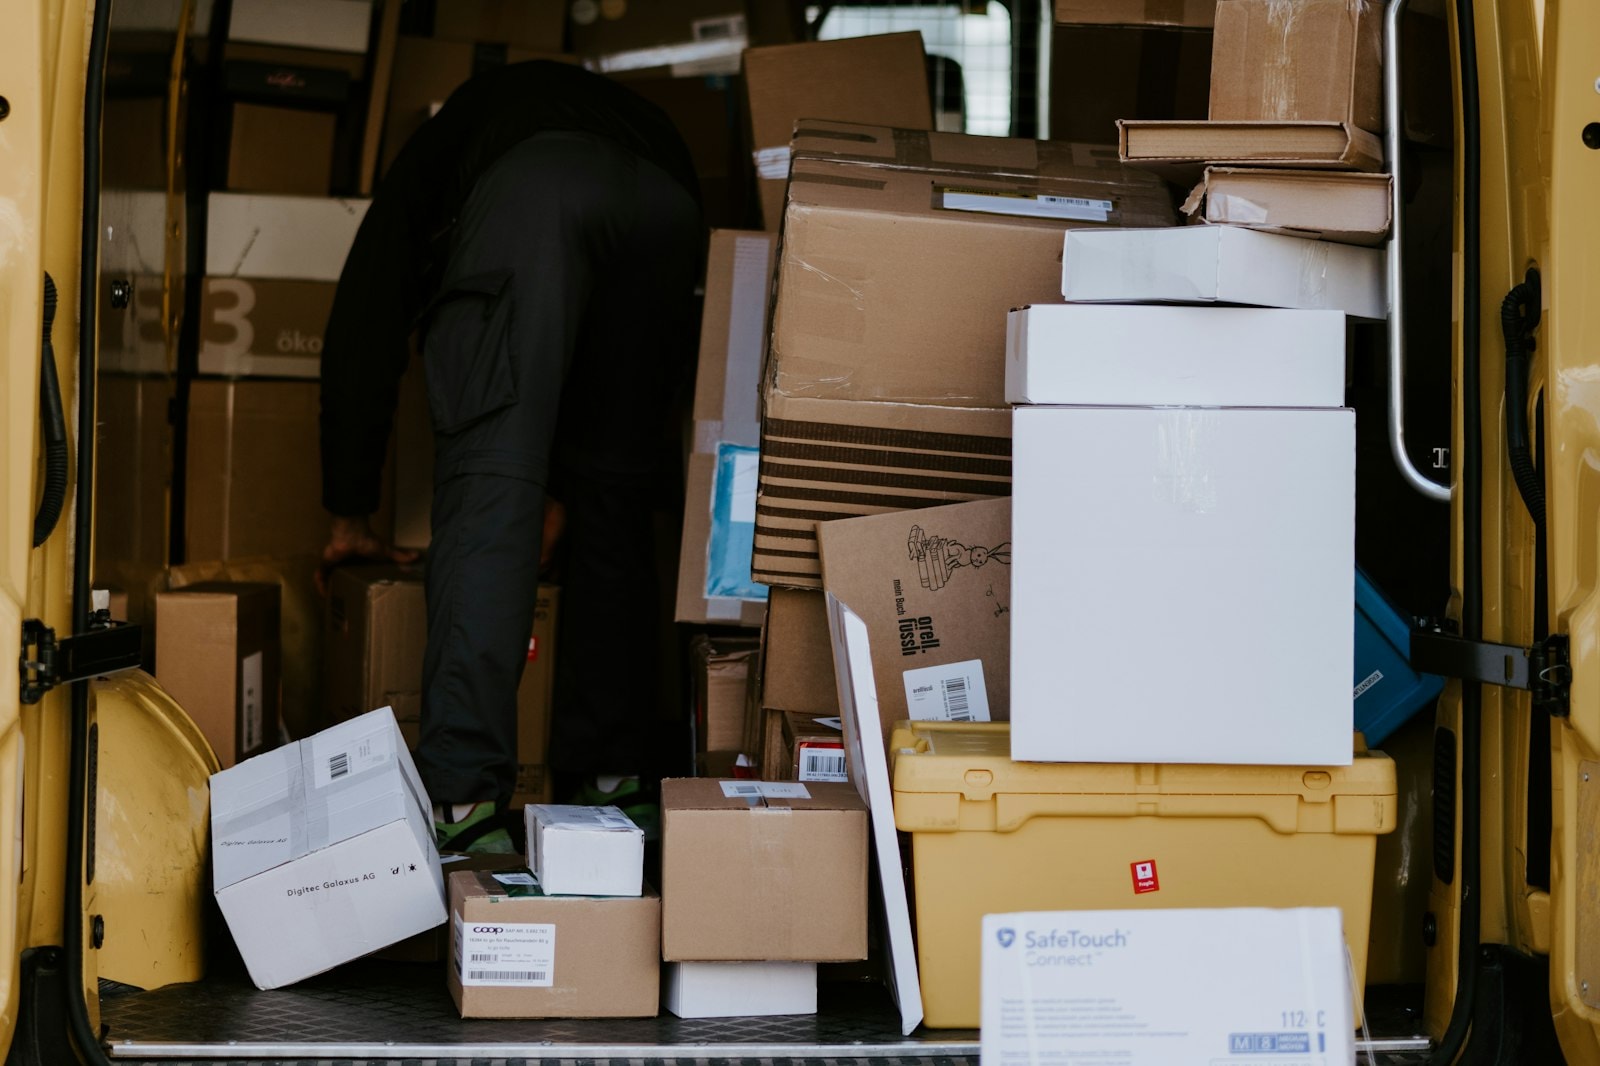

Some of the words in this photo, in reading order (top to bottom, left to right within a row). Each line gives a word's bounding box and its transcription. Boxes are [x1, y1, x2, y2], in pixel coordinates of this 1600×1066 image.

[893, 579, 902, 597] mein
[895, 597, 907, 616] Buch
[898, 617, 921, 656] füssli
[917, 616, 940, 654] orell.
[287, 884, 320, 896] Digitec
[323, 877, 359, 890] Galaxus
[362, 872, 376, 881] AG
[473, 926, 504, 935] coop
[1234, 1036, 1249, 1050] M
[1260, 1036, 1273, 1050] 8
